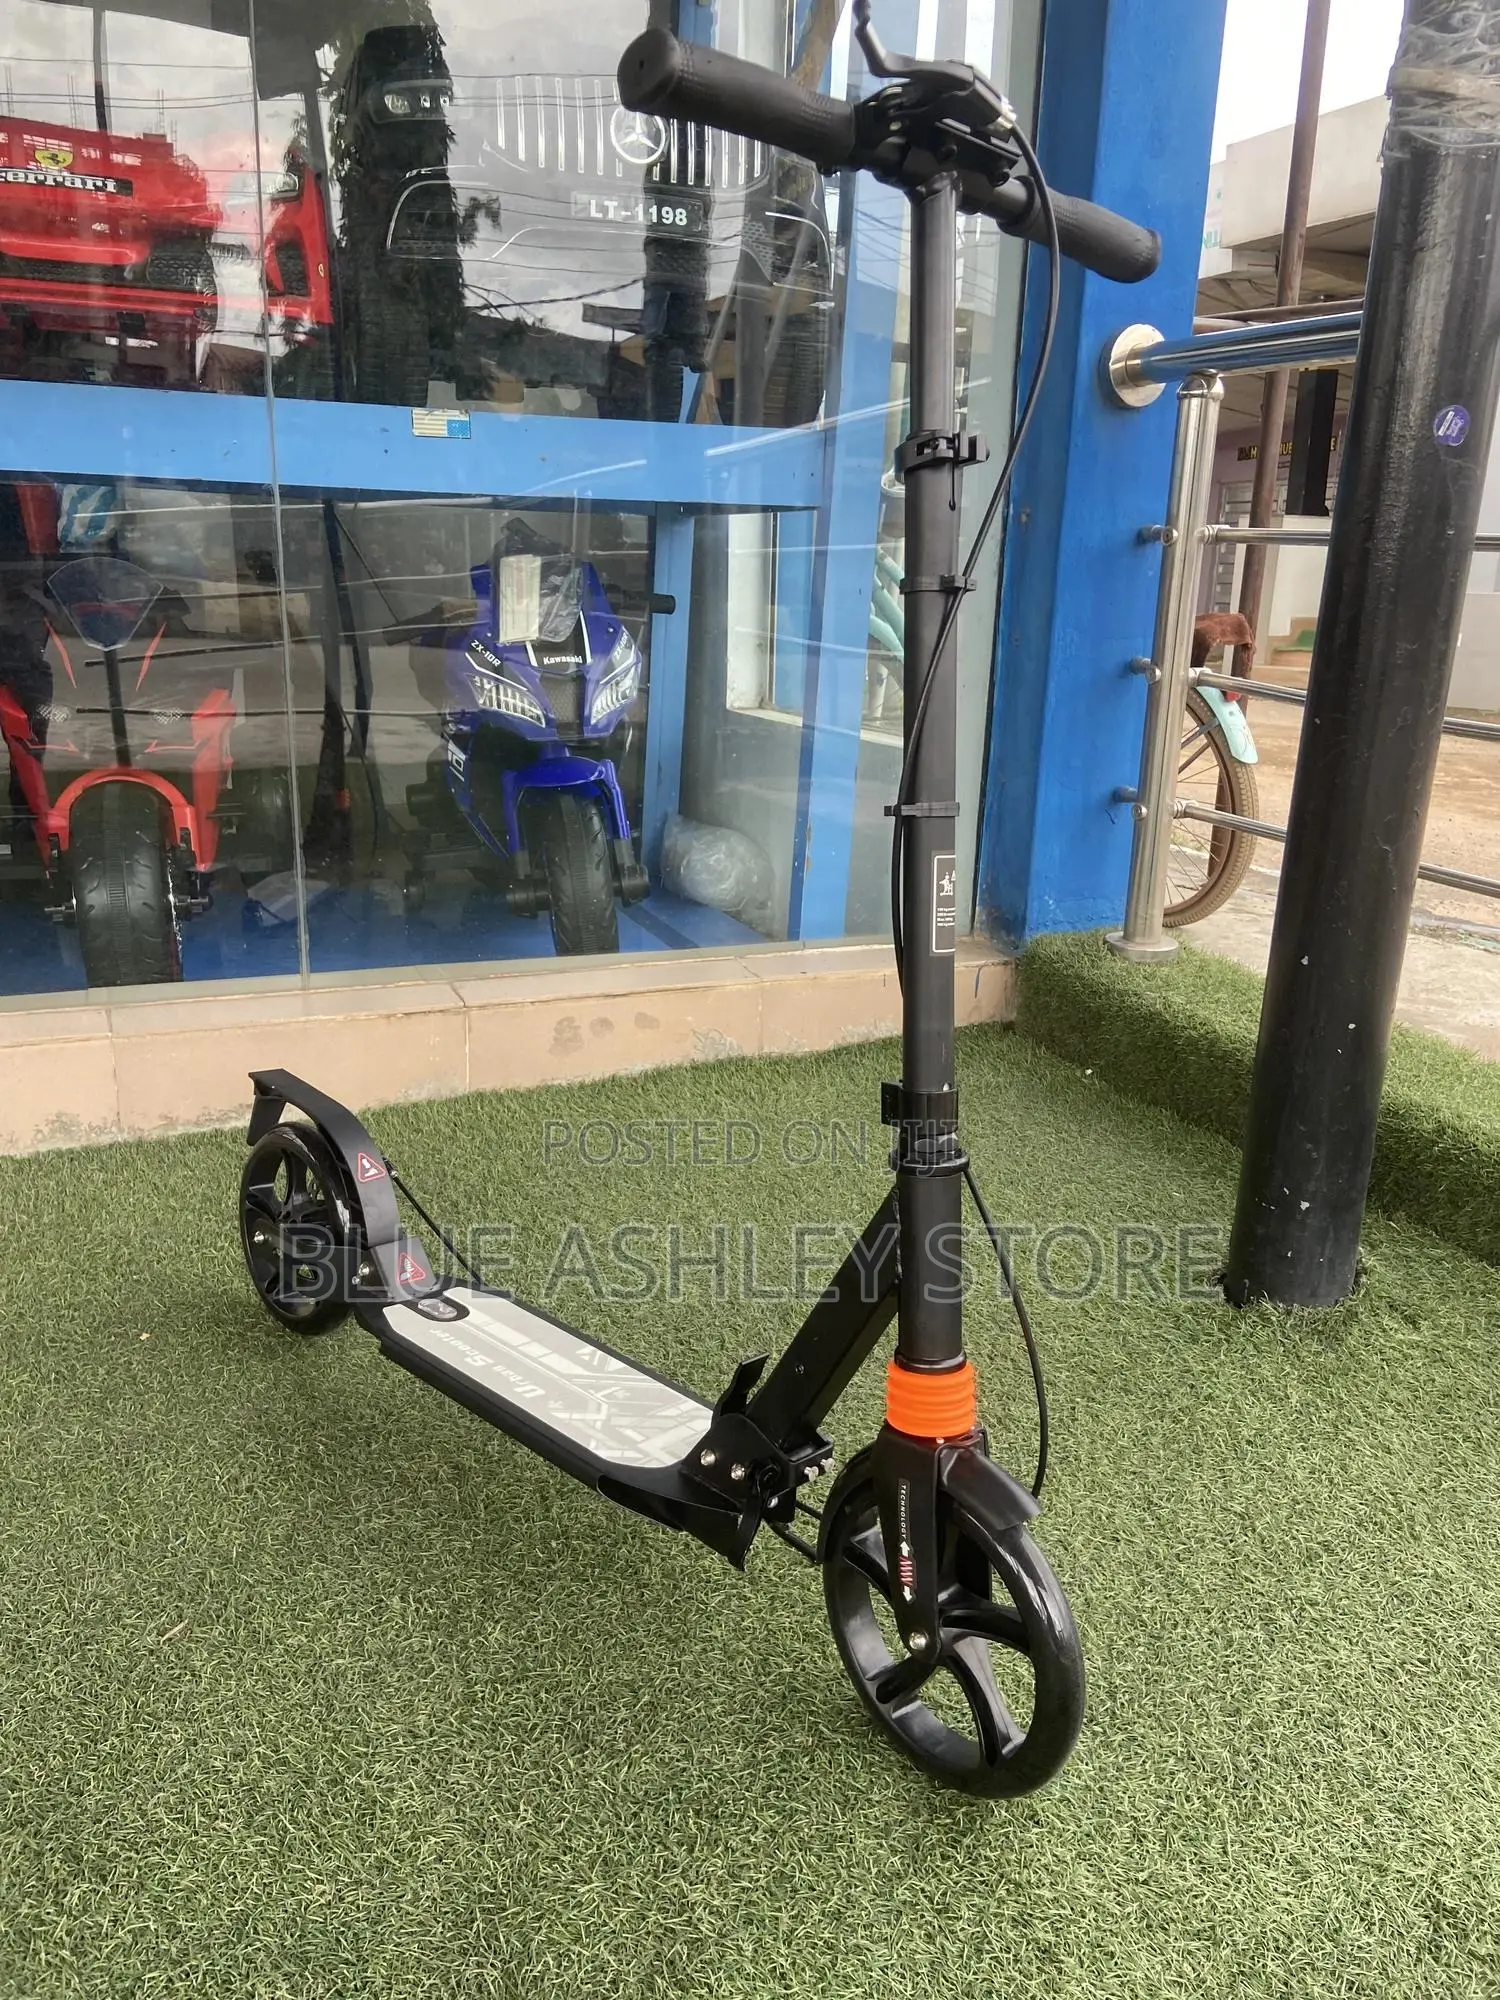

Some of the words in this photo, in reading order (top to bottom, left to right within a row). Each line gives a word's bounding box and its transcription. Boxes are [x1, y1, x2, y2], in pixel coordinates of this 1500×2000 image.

[590, 199, 688, 226] LT-1198
[470, 639, 502, 668] ZX-10R
[542, 655, 583, 665] Kawasaki
